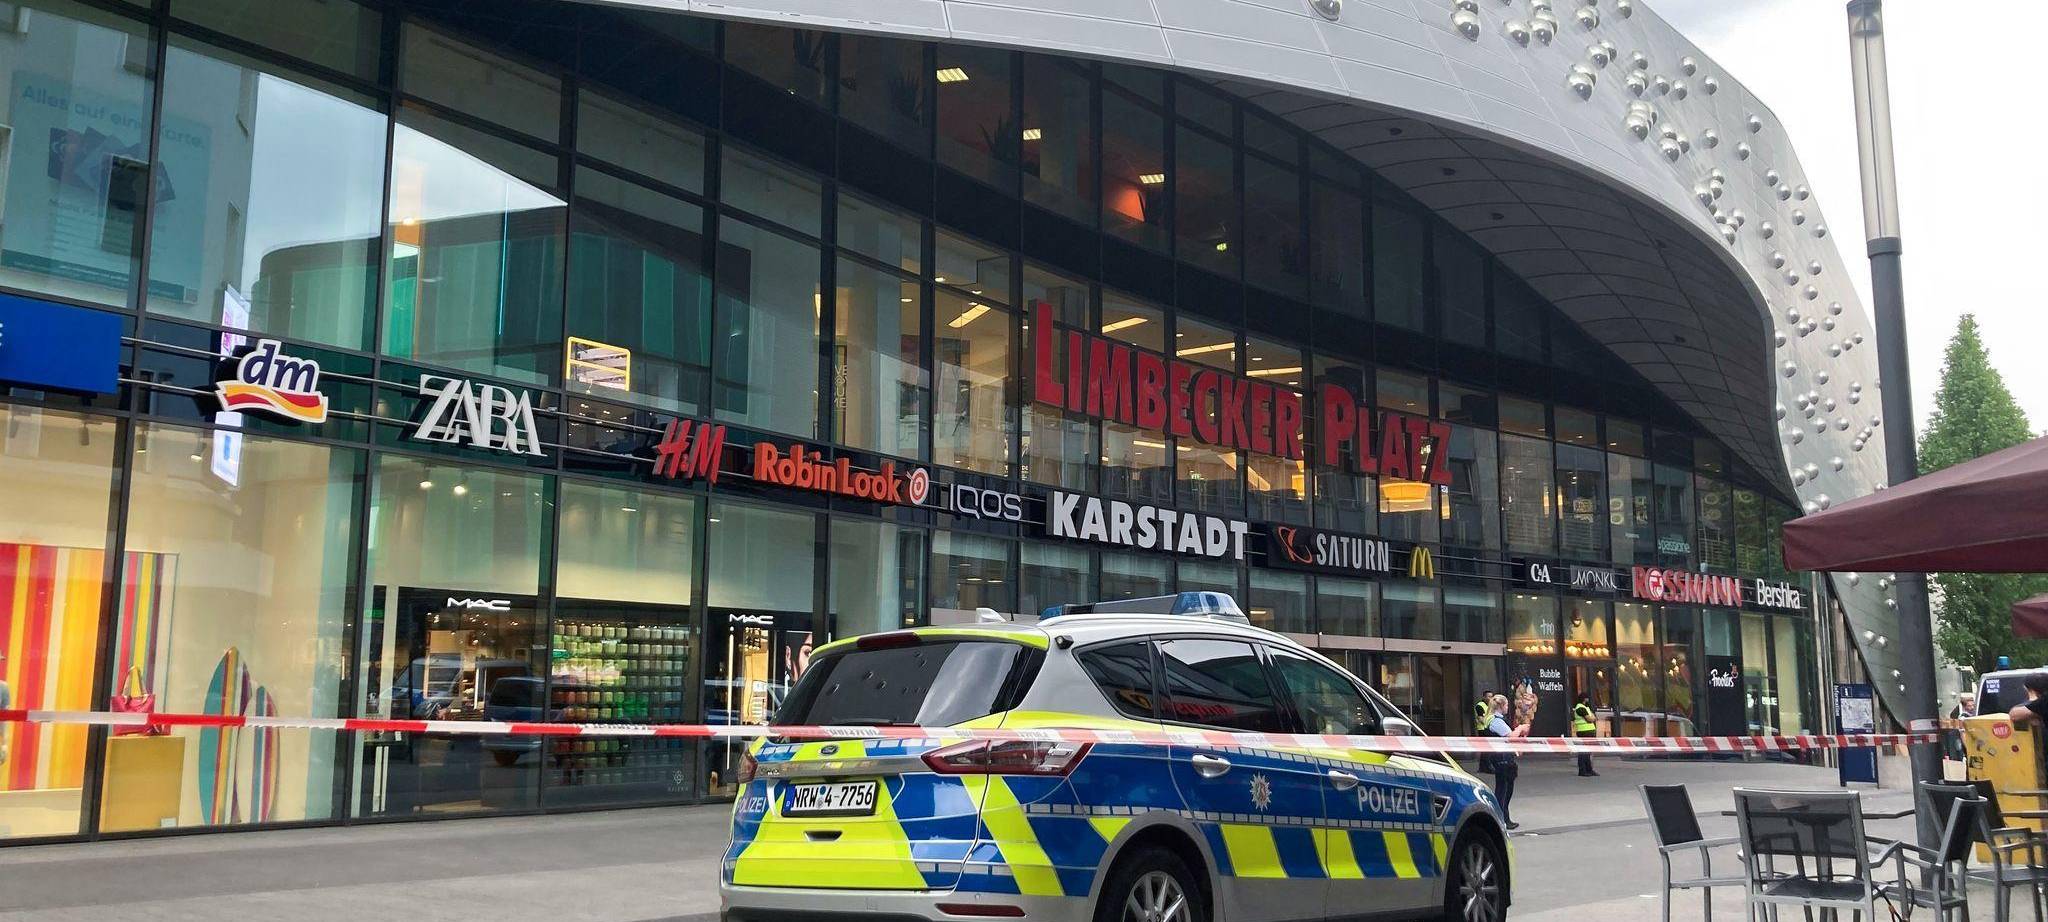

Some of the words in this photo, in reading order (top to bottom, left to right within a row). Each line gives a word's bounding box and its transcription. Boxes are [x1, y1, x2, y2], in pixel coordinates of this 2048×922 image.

[21, 85, 69, 111] Alles
[243, 343, 316, 394] dm
[1030, 300, 1302, 461] LIMBECKER
[1316, 381, 1453, 485] PLATZ
[413, 373, 548, 458] ZARA
[651, 417, 726, 485] H&M
[753, 441, 837, 491] Robin
[837, 456, 902, 502] Look
[950, 483, 1022, 521] IQOS
[1050, 490, 1248, 561] KARSTADT
[1316, 532, 1390, 572] SATURN
[1530, 562, 1551, 584] C&A
[1572, 568, 1617, 589] MONKI
[1631, 565, 1743, 608] ROSSMANN
[446, 596, 512, 612] MAC
[1756, 578, 1801, 610] Bershka
[728, 612, 774, 626] MAC
[1538, 681, 1564, 691] Waffeln
[1539, 669, 1561, 679] Bubble
[1832, 685, 1842, 717] Information
[793, 785, 817, 809] NRW
[824, 784, 874, 807] 4-7756
[1357, 785, 1421, 815] POLIZEI
